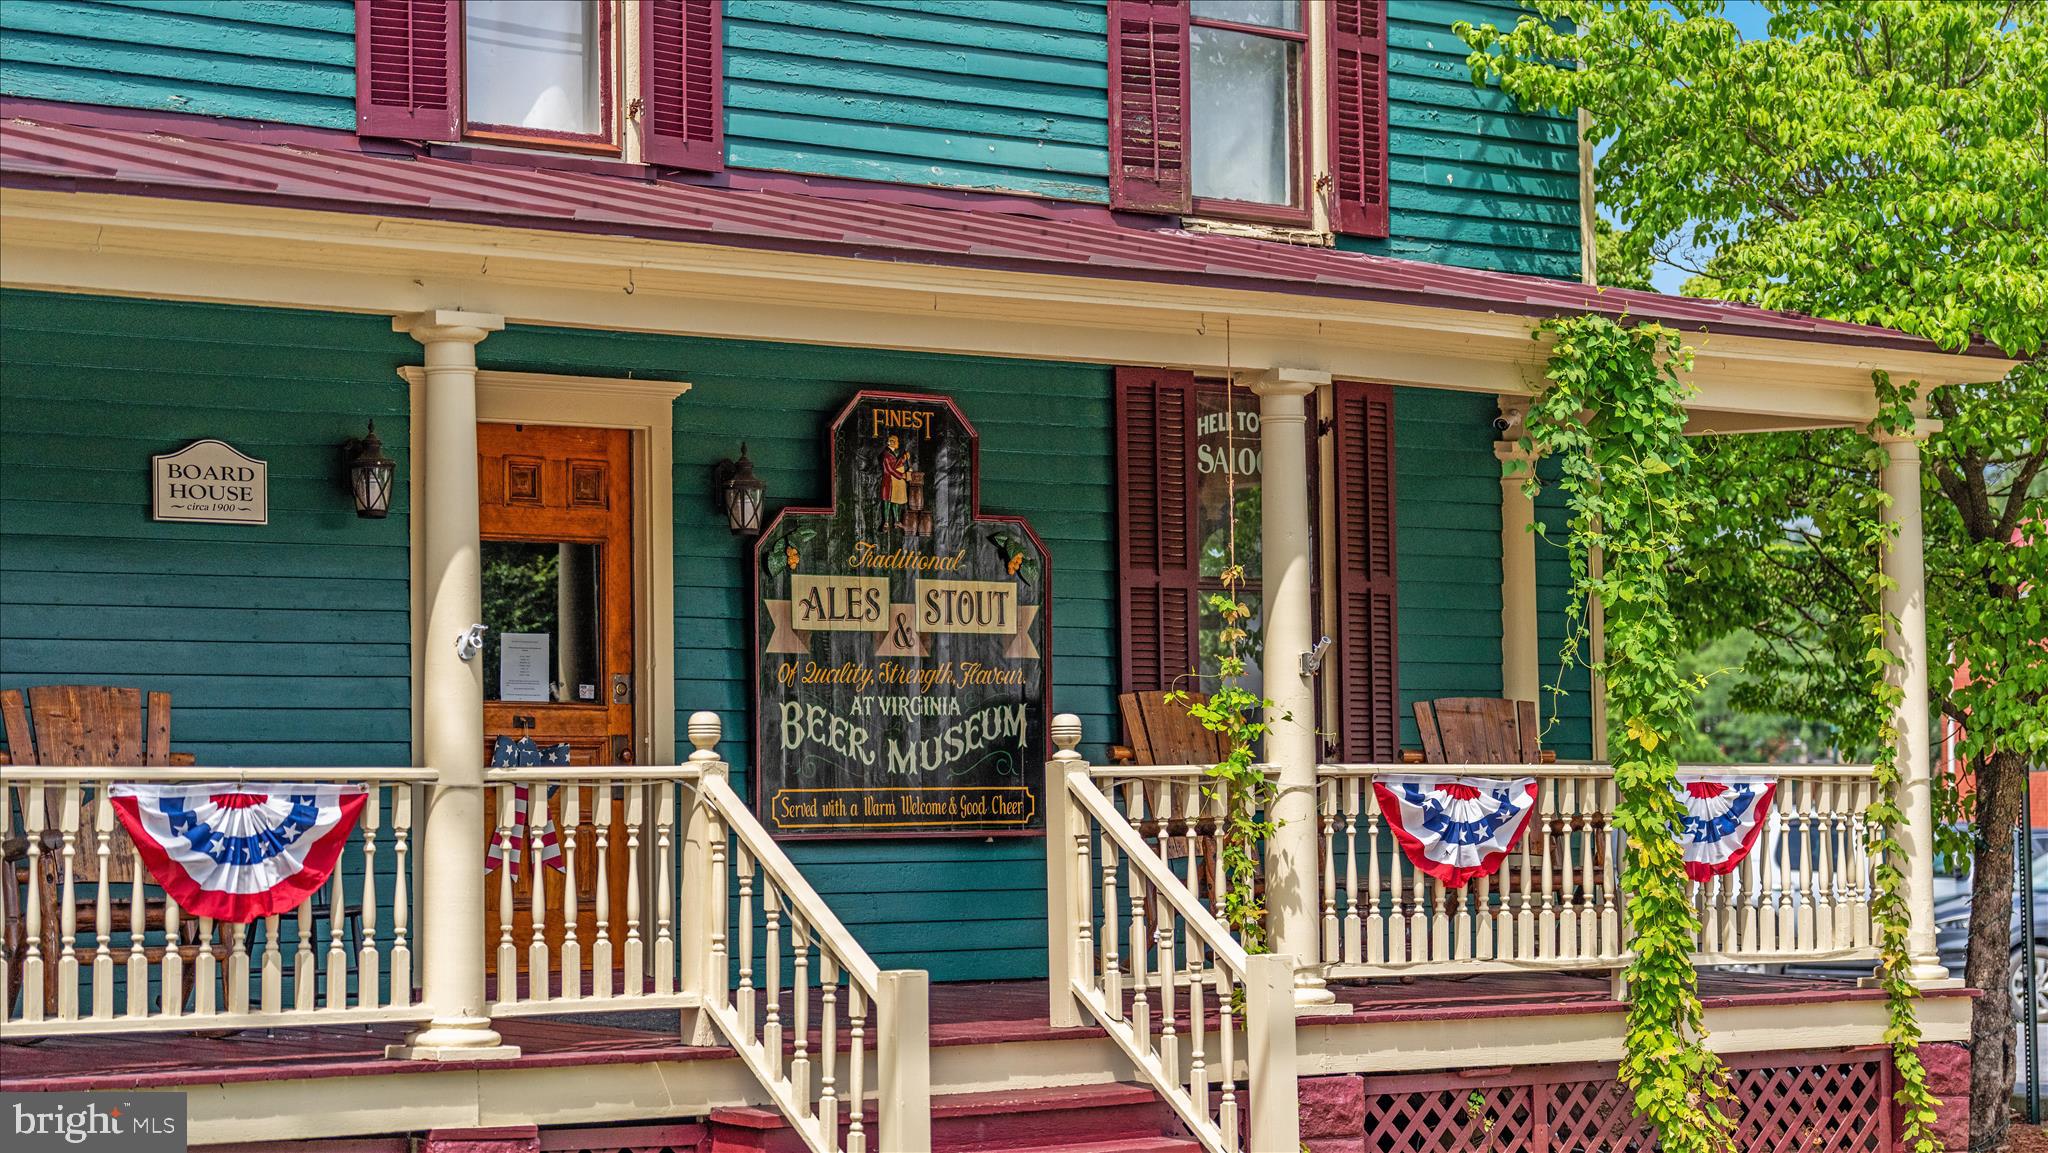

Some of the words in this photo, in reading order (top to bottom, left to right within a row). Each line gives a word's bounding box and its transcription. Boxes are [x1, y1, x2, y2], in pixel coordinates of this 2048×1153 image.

[872, 408, 935, 440] FINEST
[1197, 412, 1234, 437] HELL
[1236, 411, 1261, 433] TO
[167, 463, 255, 482] BOARD
[169, 483, 254, 502] HOUSE
[186, 503, 209, 512] circa
[212, 503, 236, 512] 1900
[848, 540, 967, 572] Traditional
[799, 586, 881, 622] ALES
[924, 588, 1010, 627] STOUT
[892, 612, 916, 650] &
[777, 661, 800, 689] Of
[801, 660, 875, 693] Quality,
[878, 660, 956, 693] Strength,
[956, 661, 1027, 690] Flavour.
[849, 695, 876, 717] AT
[877, 695, 962, 723] VIRGINIA
[779, 701, 876, 766] BEER
[886, 702, 1028, 776] MUSEUM
[780, 796, 818, 819] Served
[821, 796, 848, 818] with
[850, 803, 858, 817] a
[863, 796, 897, 817] Warm
[900, 795, 948, 817] Welcome
[948, 794, 958, 816] &
[960, 795, 988, 819] Good
[991, 795, 1024, 816] Cheer
